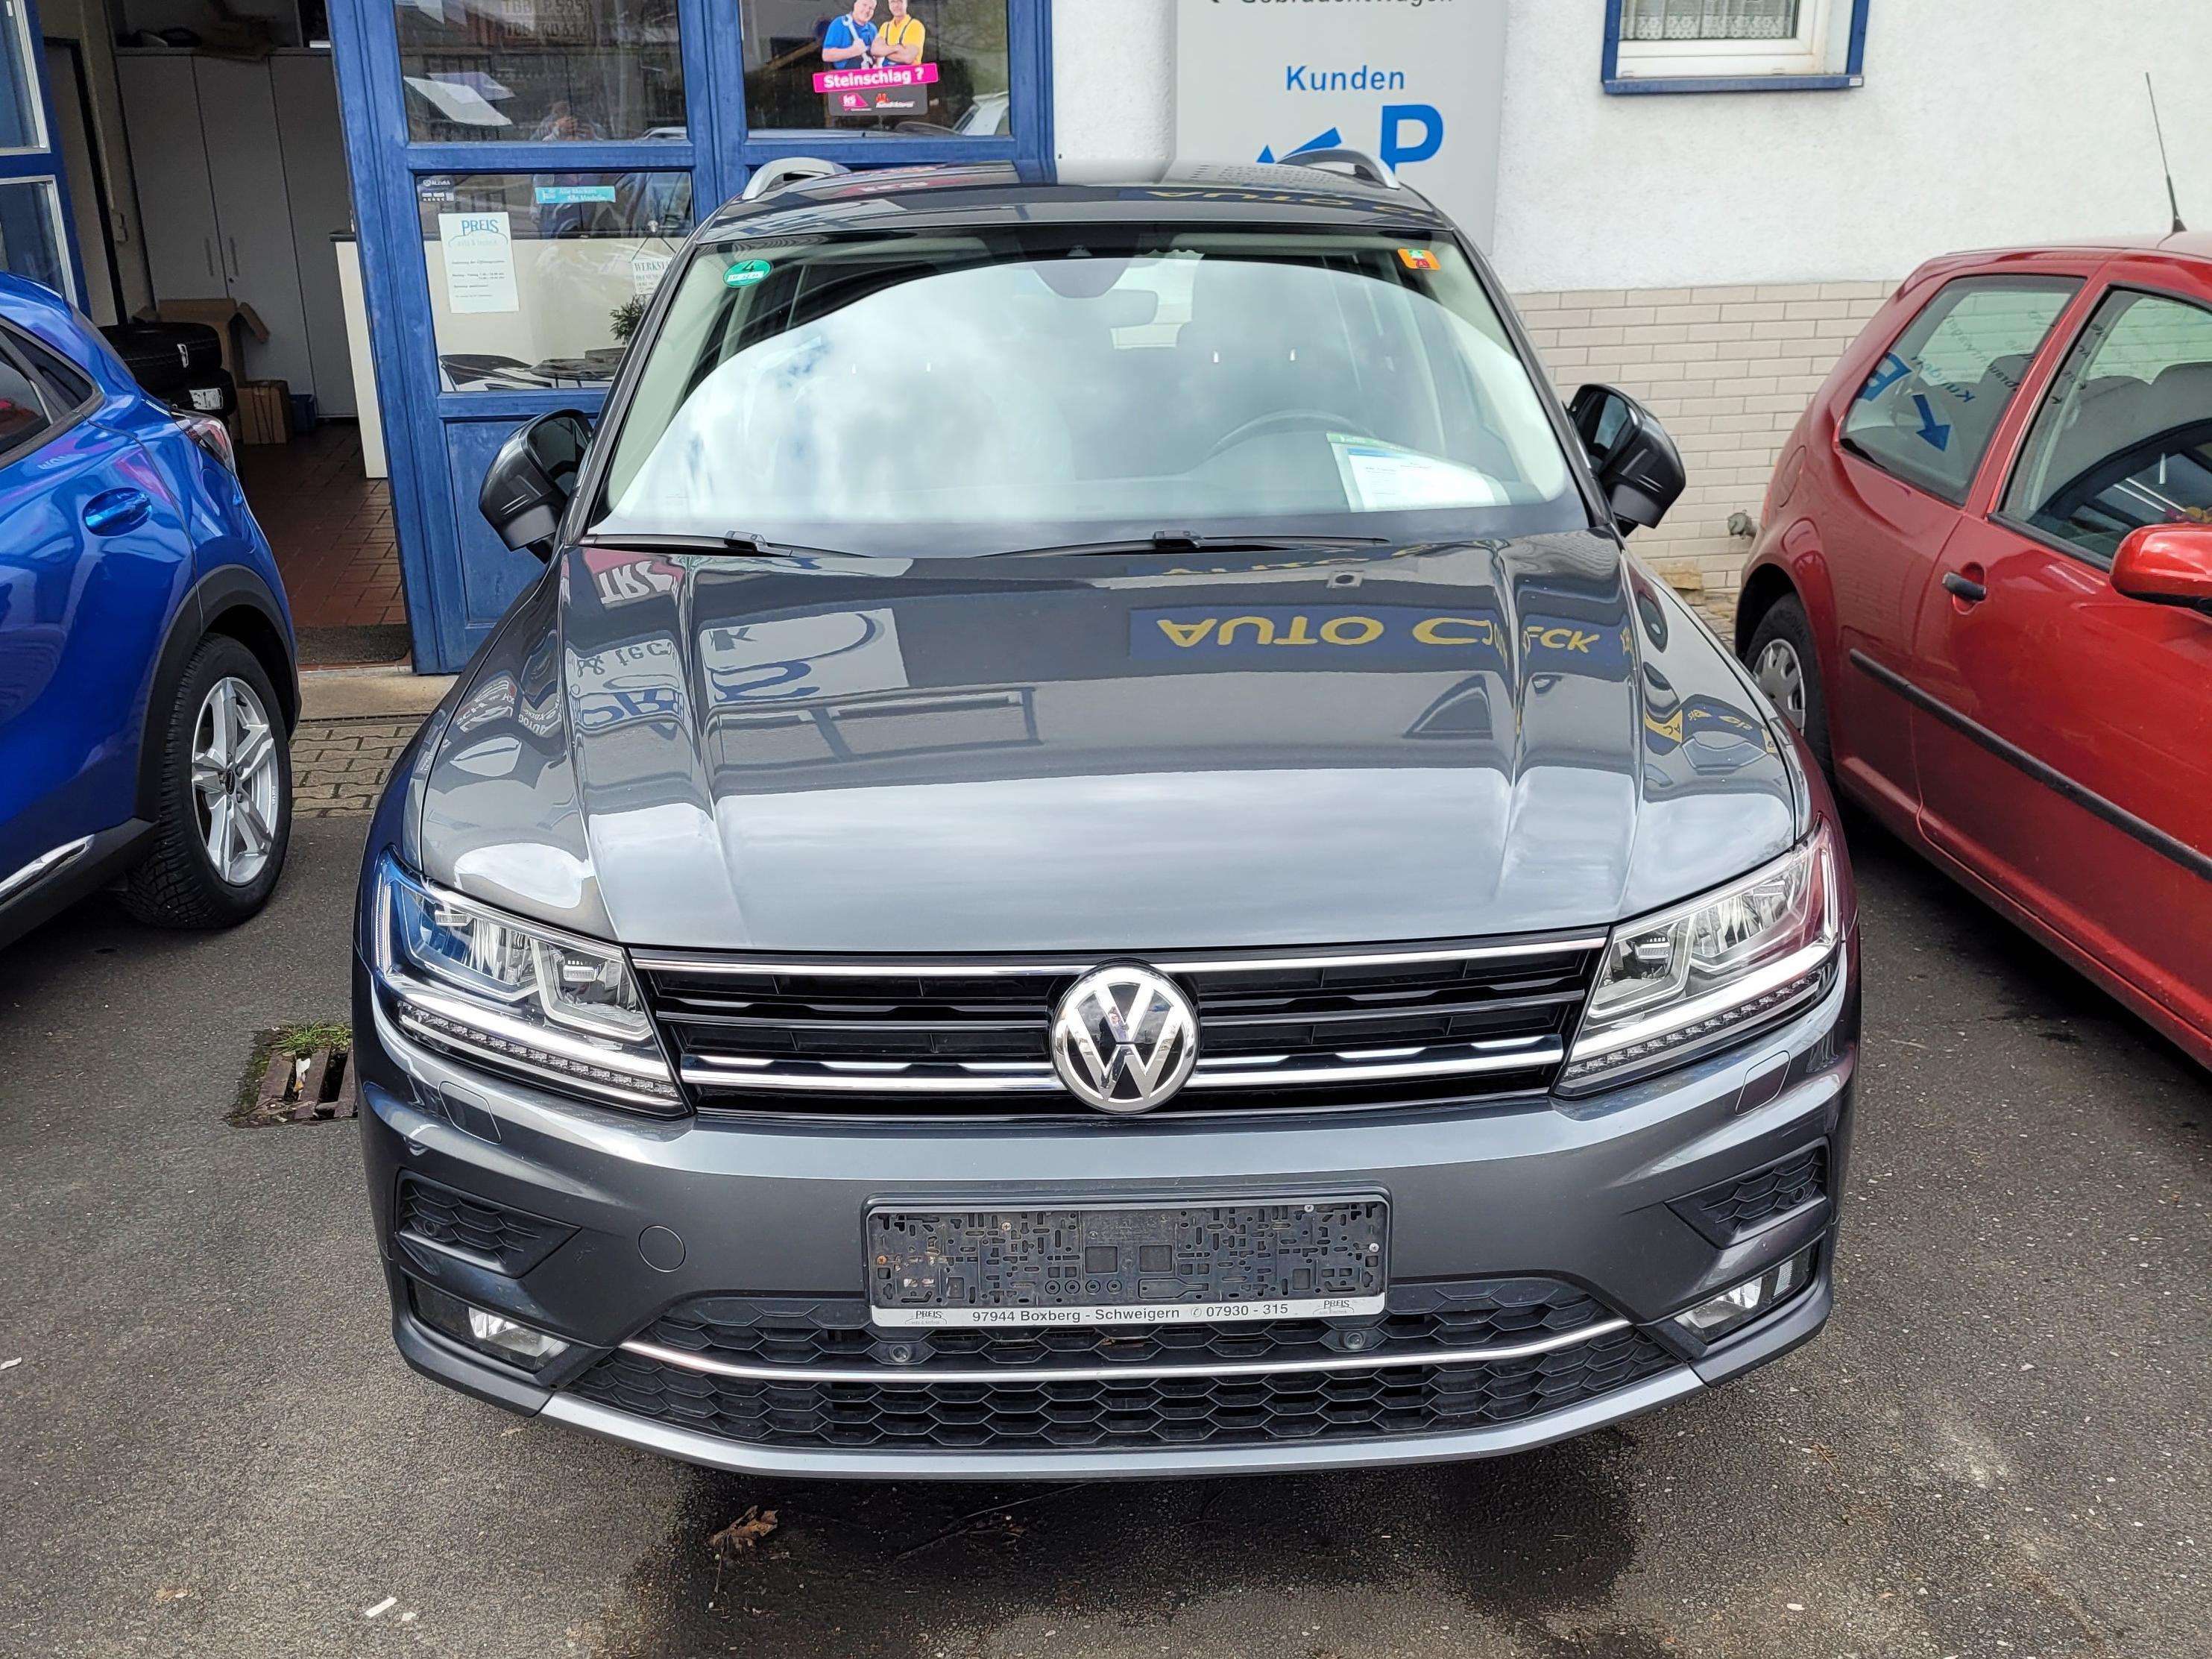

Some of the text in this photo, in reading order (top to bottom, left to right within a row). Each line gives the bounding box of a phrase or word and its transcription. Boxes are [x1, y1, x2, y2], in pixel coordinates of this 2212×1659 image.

[823, 69, 911, 89] Steinschlag
[1286, 66, 1405, 90] Kunden
[1380, 104, 1444, 174] P
[461, 219, 500, 236] PREIS
[742, 261, 754, 272] 4
[916, 1310, 942, 1319] PREIS
[972, 1311, 1015, 1322] 97944
[1021, 1309, 1080, 1323] Boxberg
[1095, 1308, 1180, 1322] Schweigern
[1206, 1306, 1249, 1317] 07930
[1263, 1304, 1288, 1315] 315
[1323, 1300, 1350, 1309] PREIS
